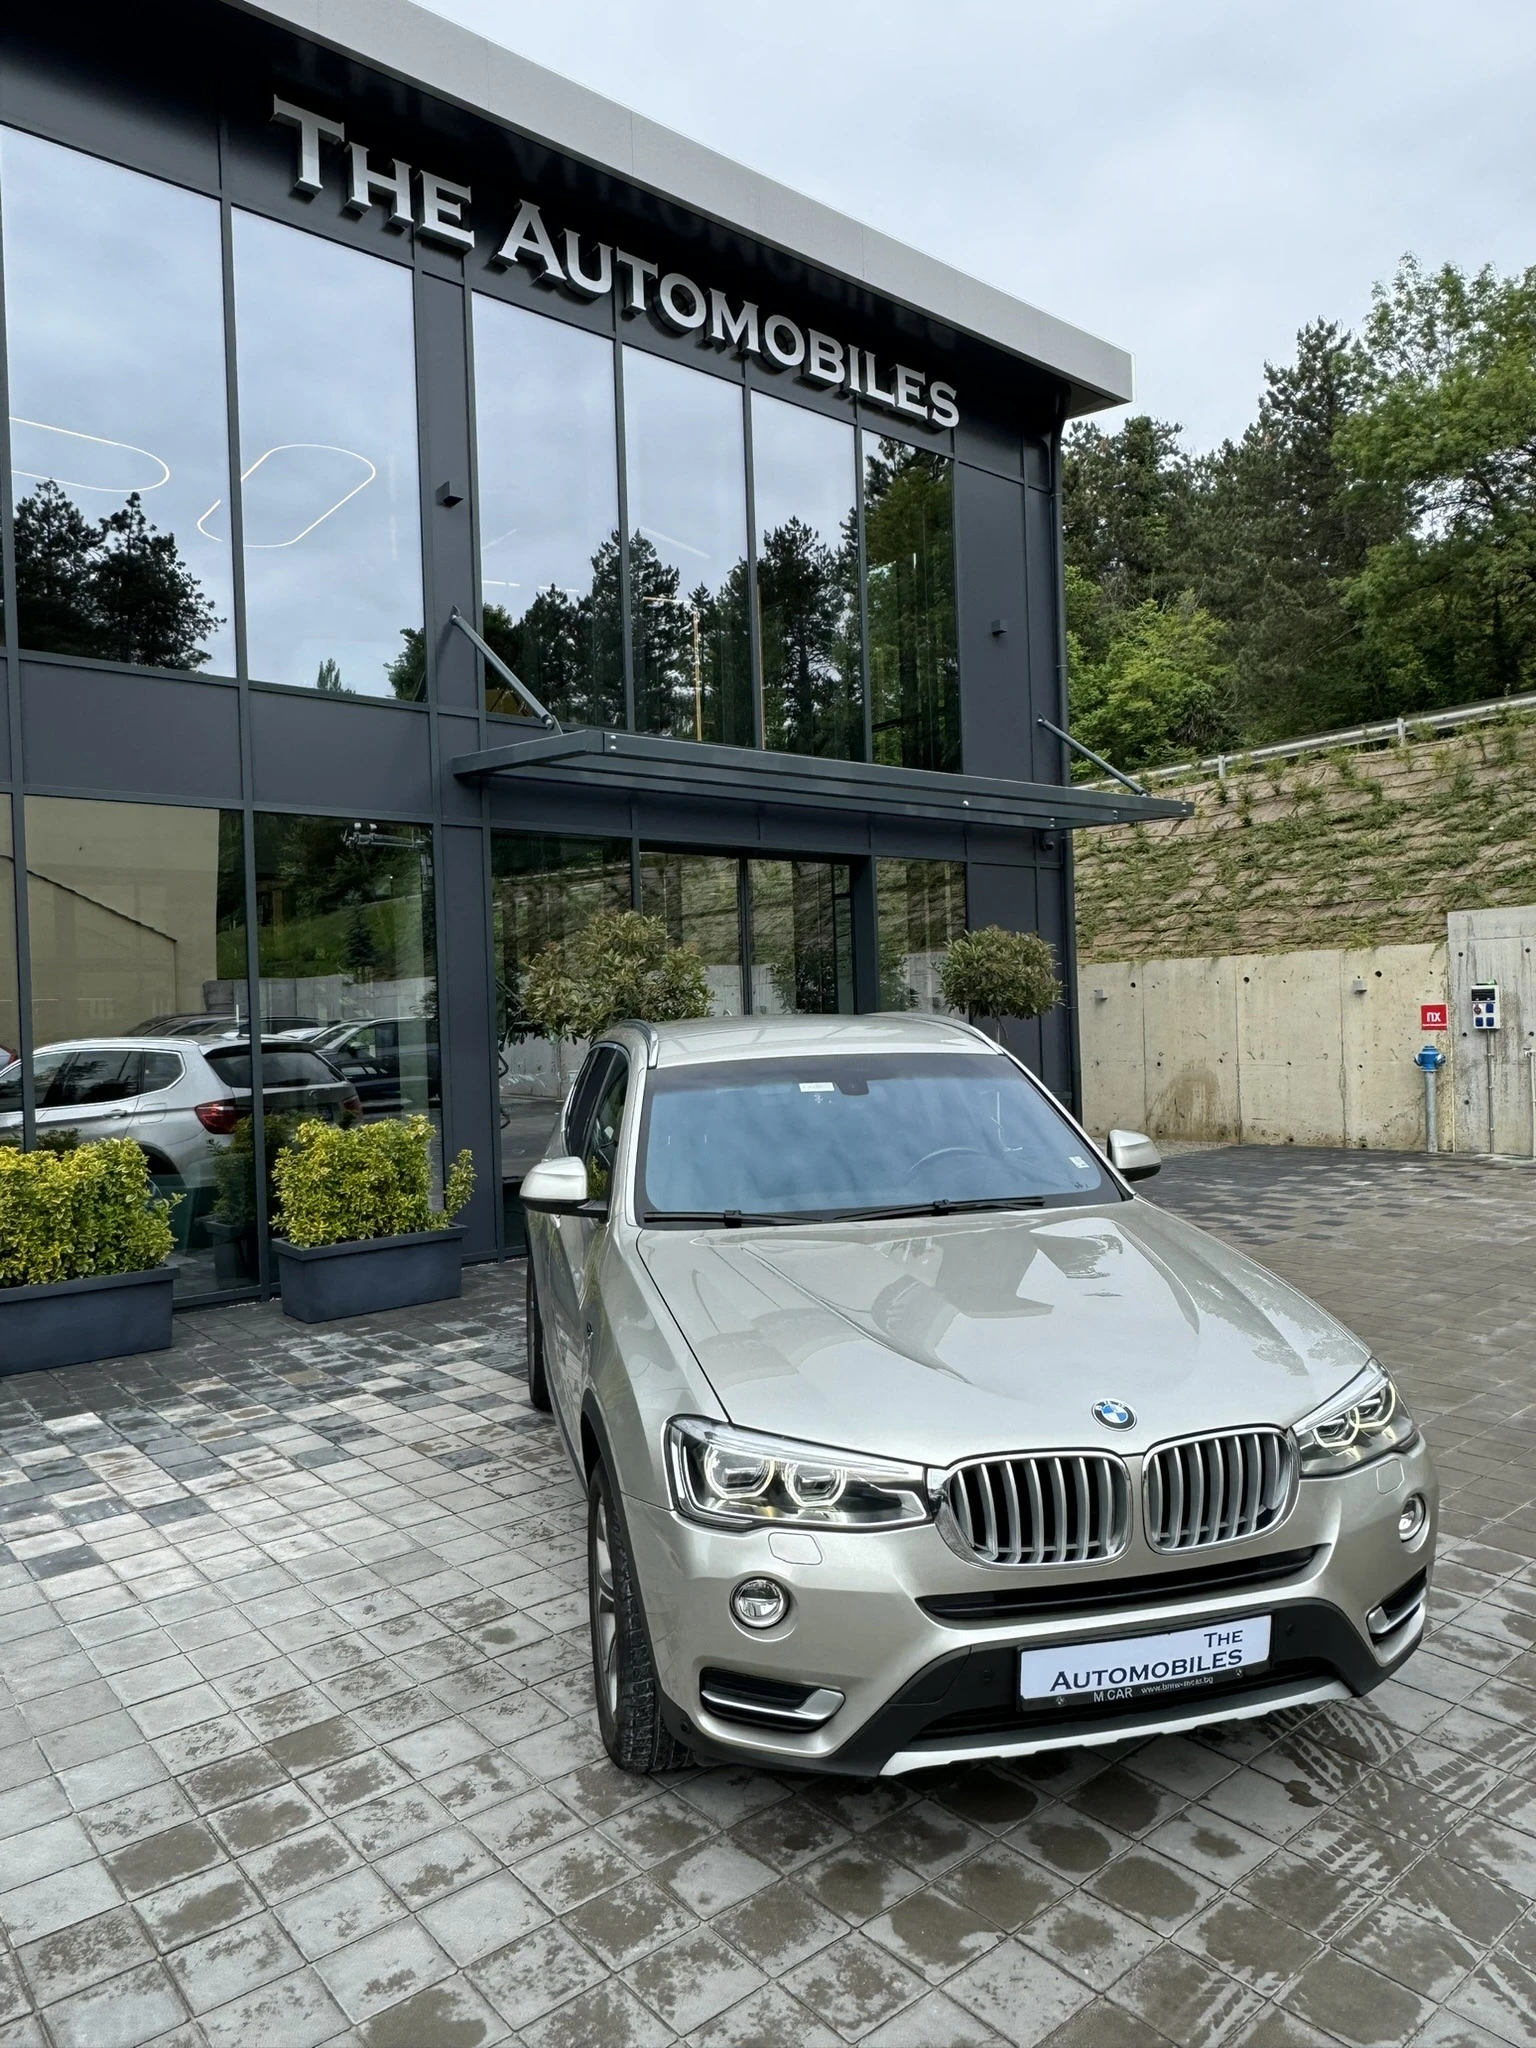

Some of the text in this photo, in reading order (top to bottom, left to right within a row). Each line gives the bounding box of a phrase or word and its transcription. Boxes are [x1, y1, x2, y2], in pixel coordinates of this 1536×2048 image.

[272, 93, 960, 428] THE AUTOMOBILES
[1203, 1630, 1243, 1648] THE
[1049, 1648, 1243, 1692] AUTOMOBILES
